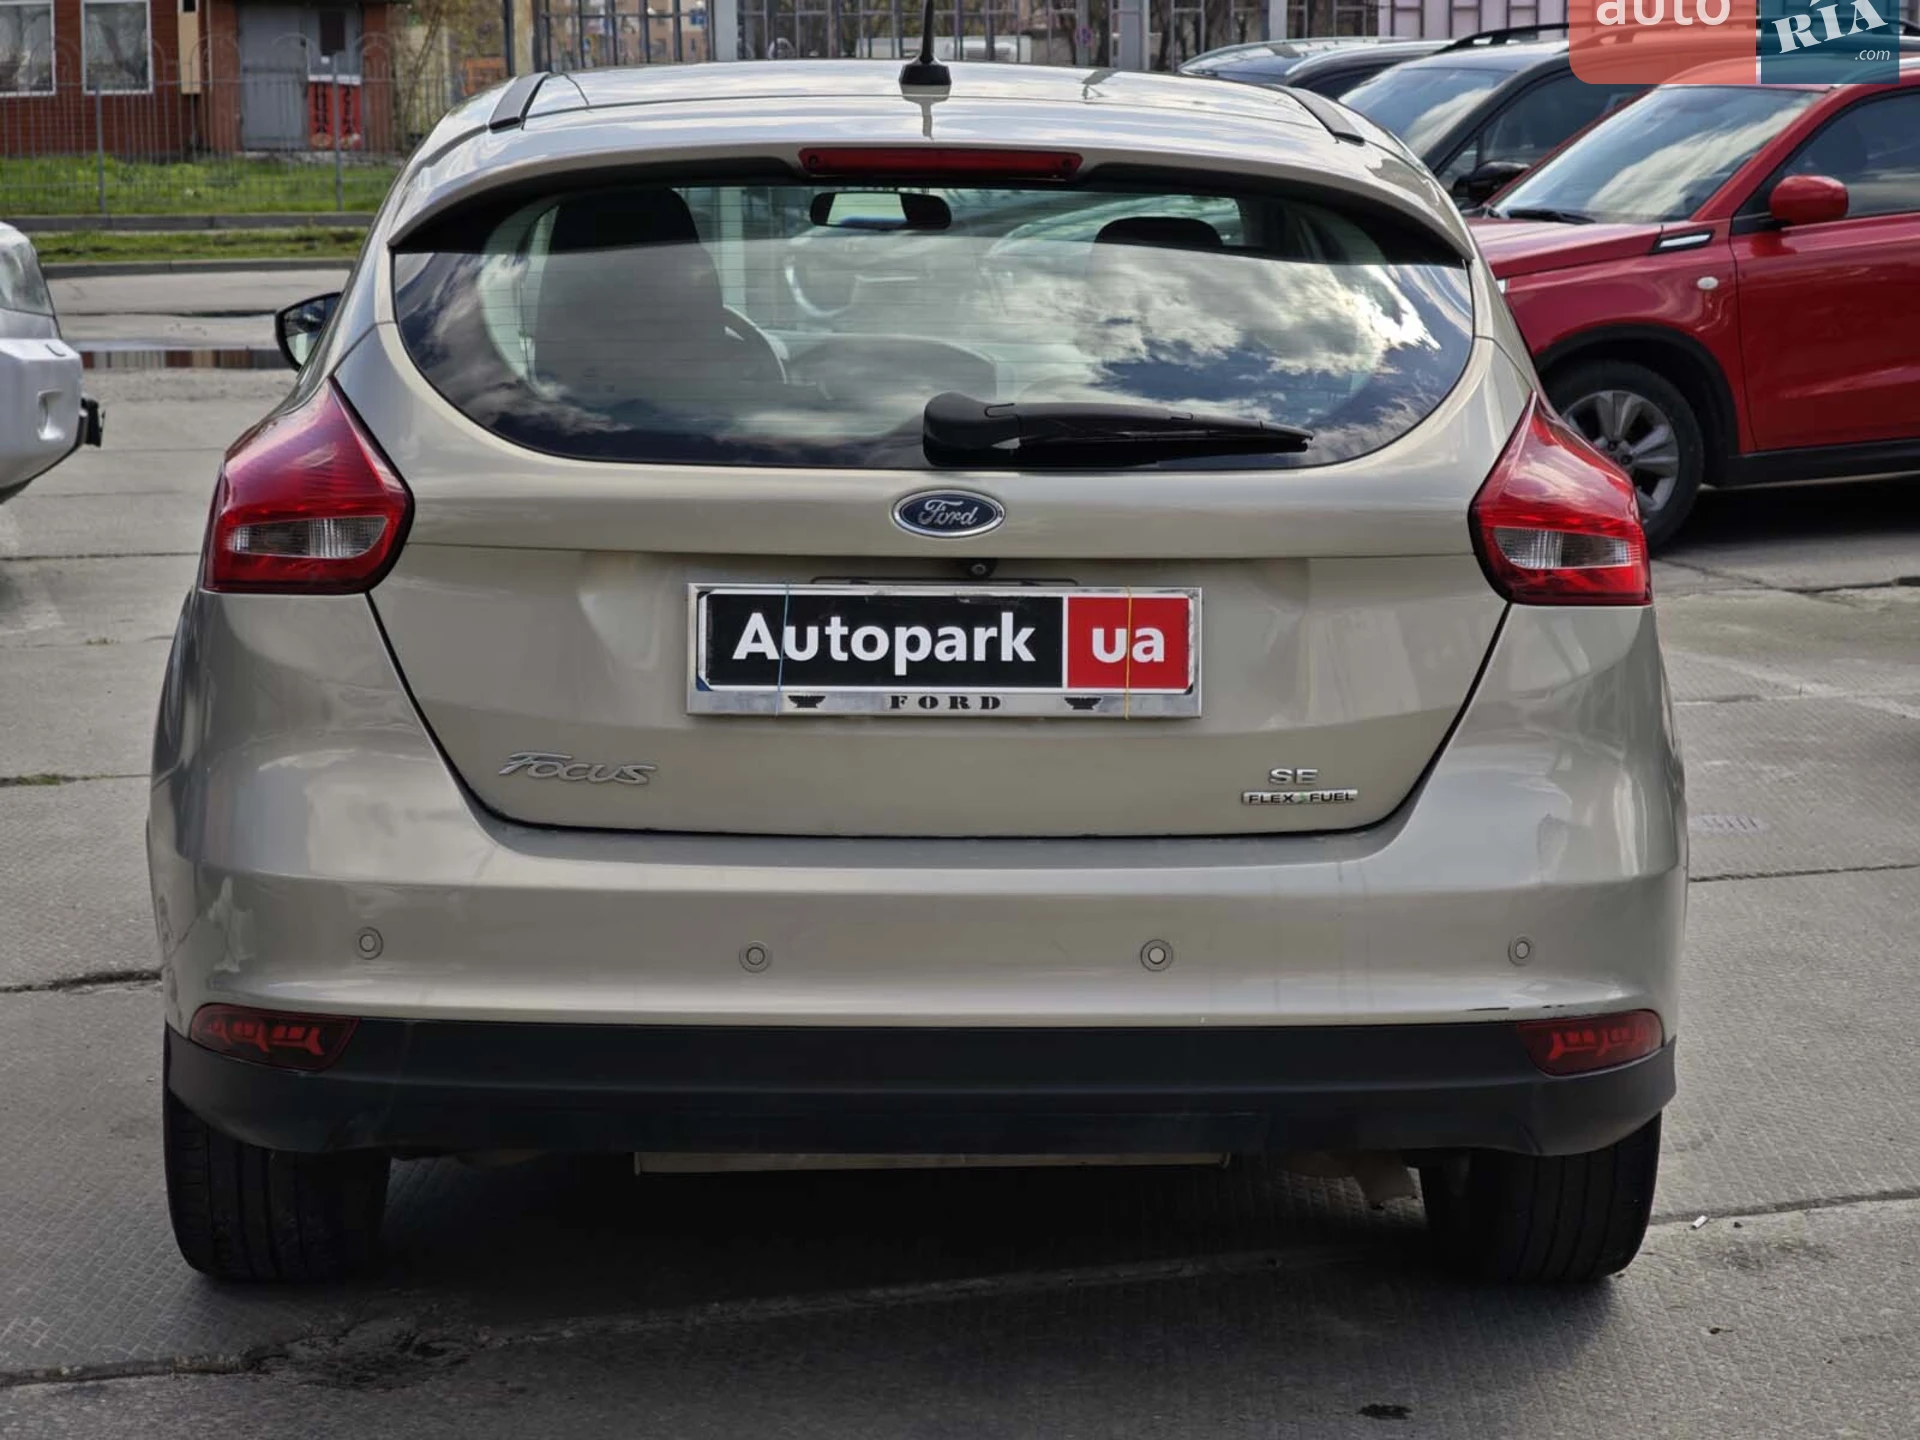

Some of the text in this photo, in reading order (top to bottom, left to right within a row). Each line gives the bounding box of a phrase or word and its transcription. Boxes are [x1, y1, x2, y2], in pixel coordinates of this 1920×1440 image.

[919, 499, 979, 525] Ford
[732, 611, 1165, 676] Autopark ua
[890, 695, 1001, 710] FORD
[1269, 768, 1318, 784] SE
[1248, 792, 1355, 804] FLEX FUEL
